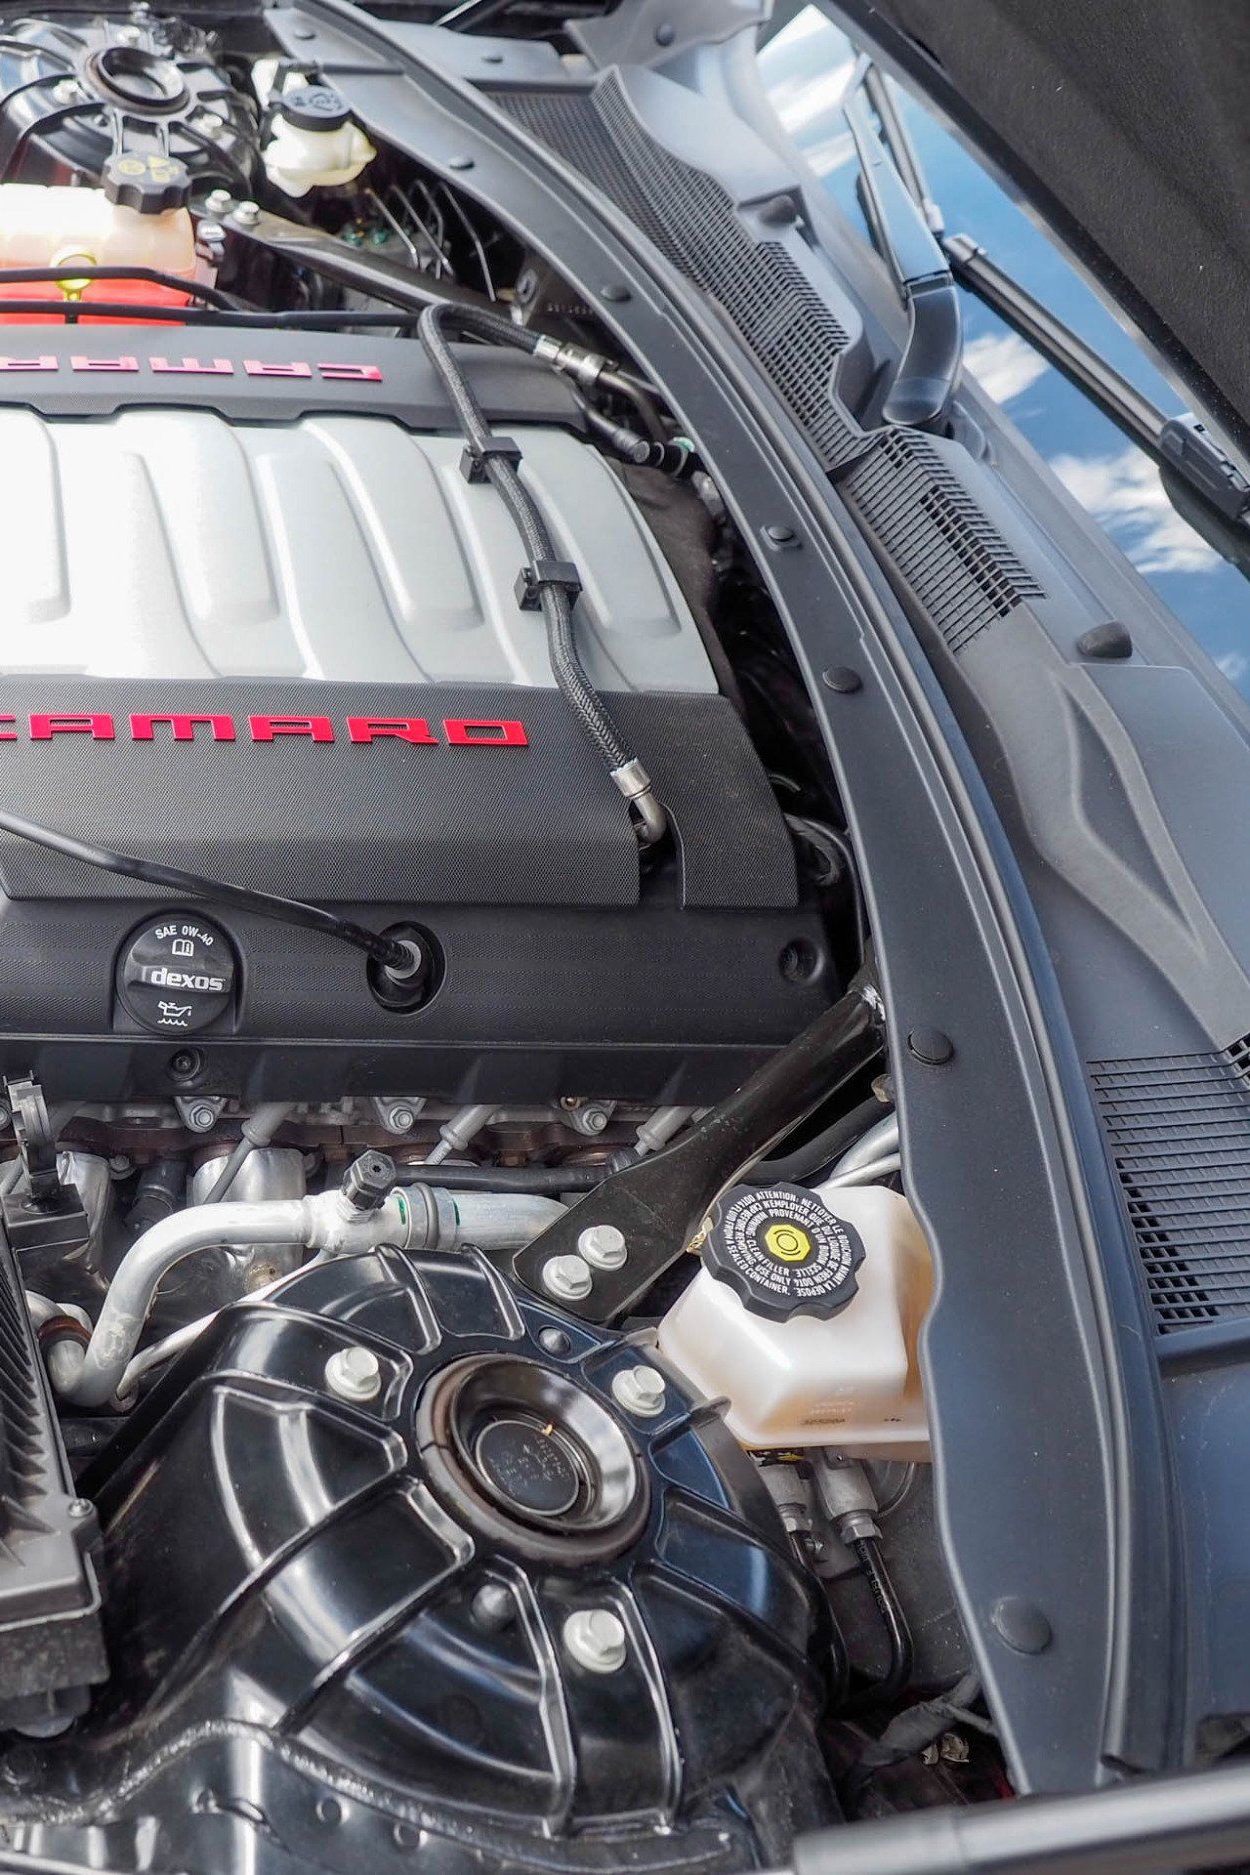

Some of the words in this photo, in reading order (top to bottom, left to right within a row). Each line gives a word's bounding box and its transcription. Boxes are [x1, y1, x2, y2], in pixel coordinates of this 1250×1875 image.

[155, 925, 177, 939] SAE
[182, 925, 214, 946] 0W-40
[151, 967, 224, 991] dexos
[746, 1202, 763, 1214] CAP
[801, 1198, 837, 1225] NETTOYER
[768, 1209, 814, 1228] PROVENANT
[809, 1212, 824, 1226] QUE
[821, 1225, 833, 1235] DU
[832, 1224, 844, 1234] LE
[727, 1245, 749, 1270] SEALED
[746, 1239, 765, 1261] CLEAN
[761, 1258, 789, 1276] FILLER
[754, 1264, 770, 1277] USE
[826, 1260, 839, 1271] DE
[770, 1273, 791, 1286] ONLY
[822, 1280, 836, 1291] LA
